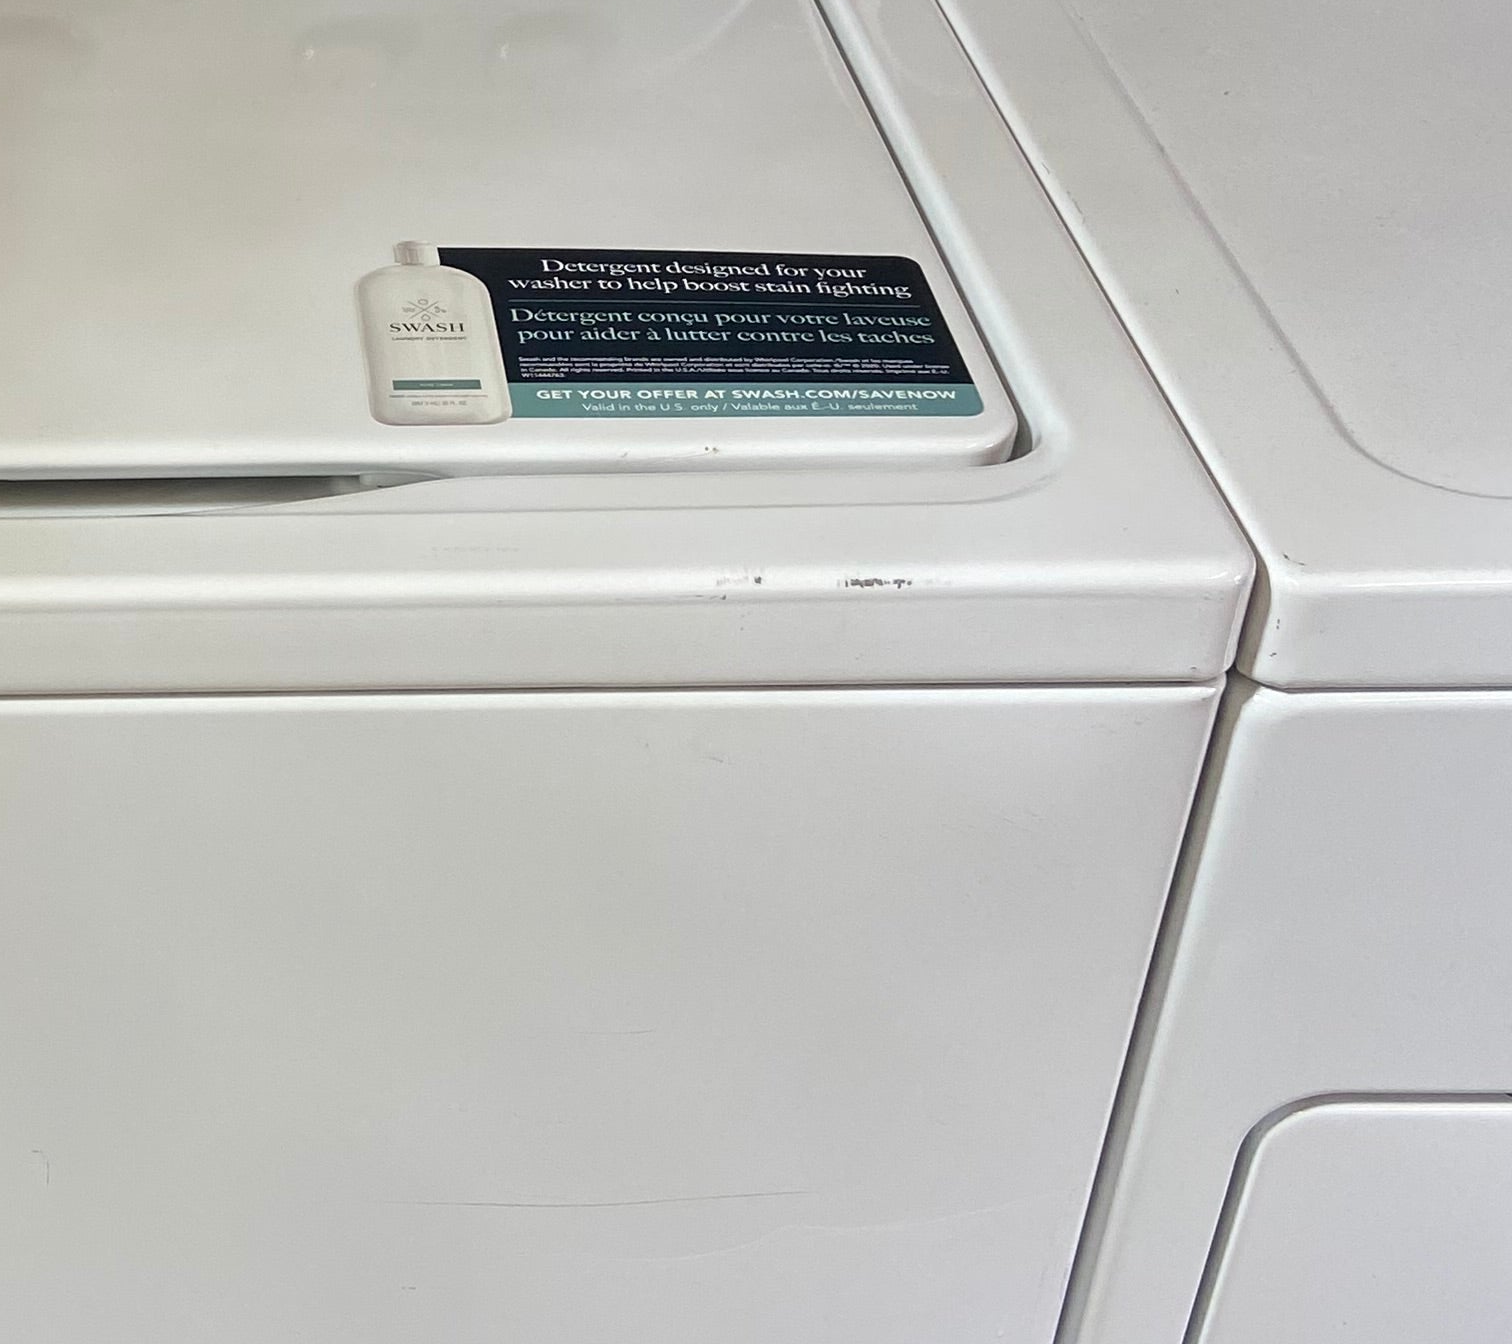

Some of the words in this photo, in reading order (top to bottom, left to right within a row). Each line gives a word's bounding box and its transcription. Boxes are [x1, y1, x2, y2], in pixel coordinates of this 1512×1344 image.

[540, 258, 662, 276] Detergent
[665, 261, 770, 278] designed
[776, 264, 809, 277] for
[813, 267, 867, 280] your
[508, 277, 592, 290] washer
[597, 278, 623, 290] to
[628, 277, 678, 294] help
[682, 278, 751, 292] boost
[755, 282, 811, 294] stain
[815, 282, 912, 299] fighting
[510, 308, 633, 326] Détergent
[637, 312, 709, 326] conçu
[714, 312, 771, 326] pour
[776, 314, 839, 326] votre
[843, 313, 932, 326] laveuse
[390, 323, 464, 332] SWASH
[517, 329, 574, 344] pour
[581, 327, 640, 341] aider
[647, 327, 661, 341] à
[667, 328, 732, 342] lutter
[737, 330, 815, 343] contre
[819, 330, 853, 343] les
[857, 331, 935, 344] taches
[537, 390, 572, 399] GET
[577, 390, 631, 399] YOUR
[637, 390, 698, 399] OFFER
[705, 390, 725, 398] AT
[732, 390, 955, 399] SWASH.COM/SAVENOW
[582, 403, 616, 412] Valid
[618, 403, 631, 412] in
[634, 403, 656, 412] the
[690, 403, 718, 413] only
[731, 403, 781, 411] Valable
[848, 403, 918, 411] seulement
